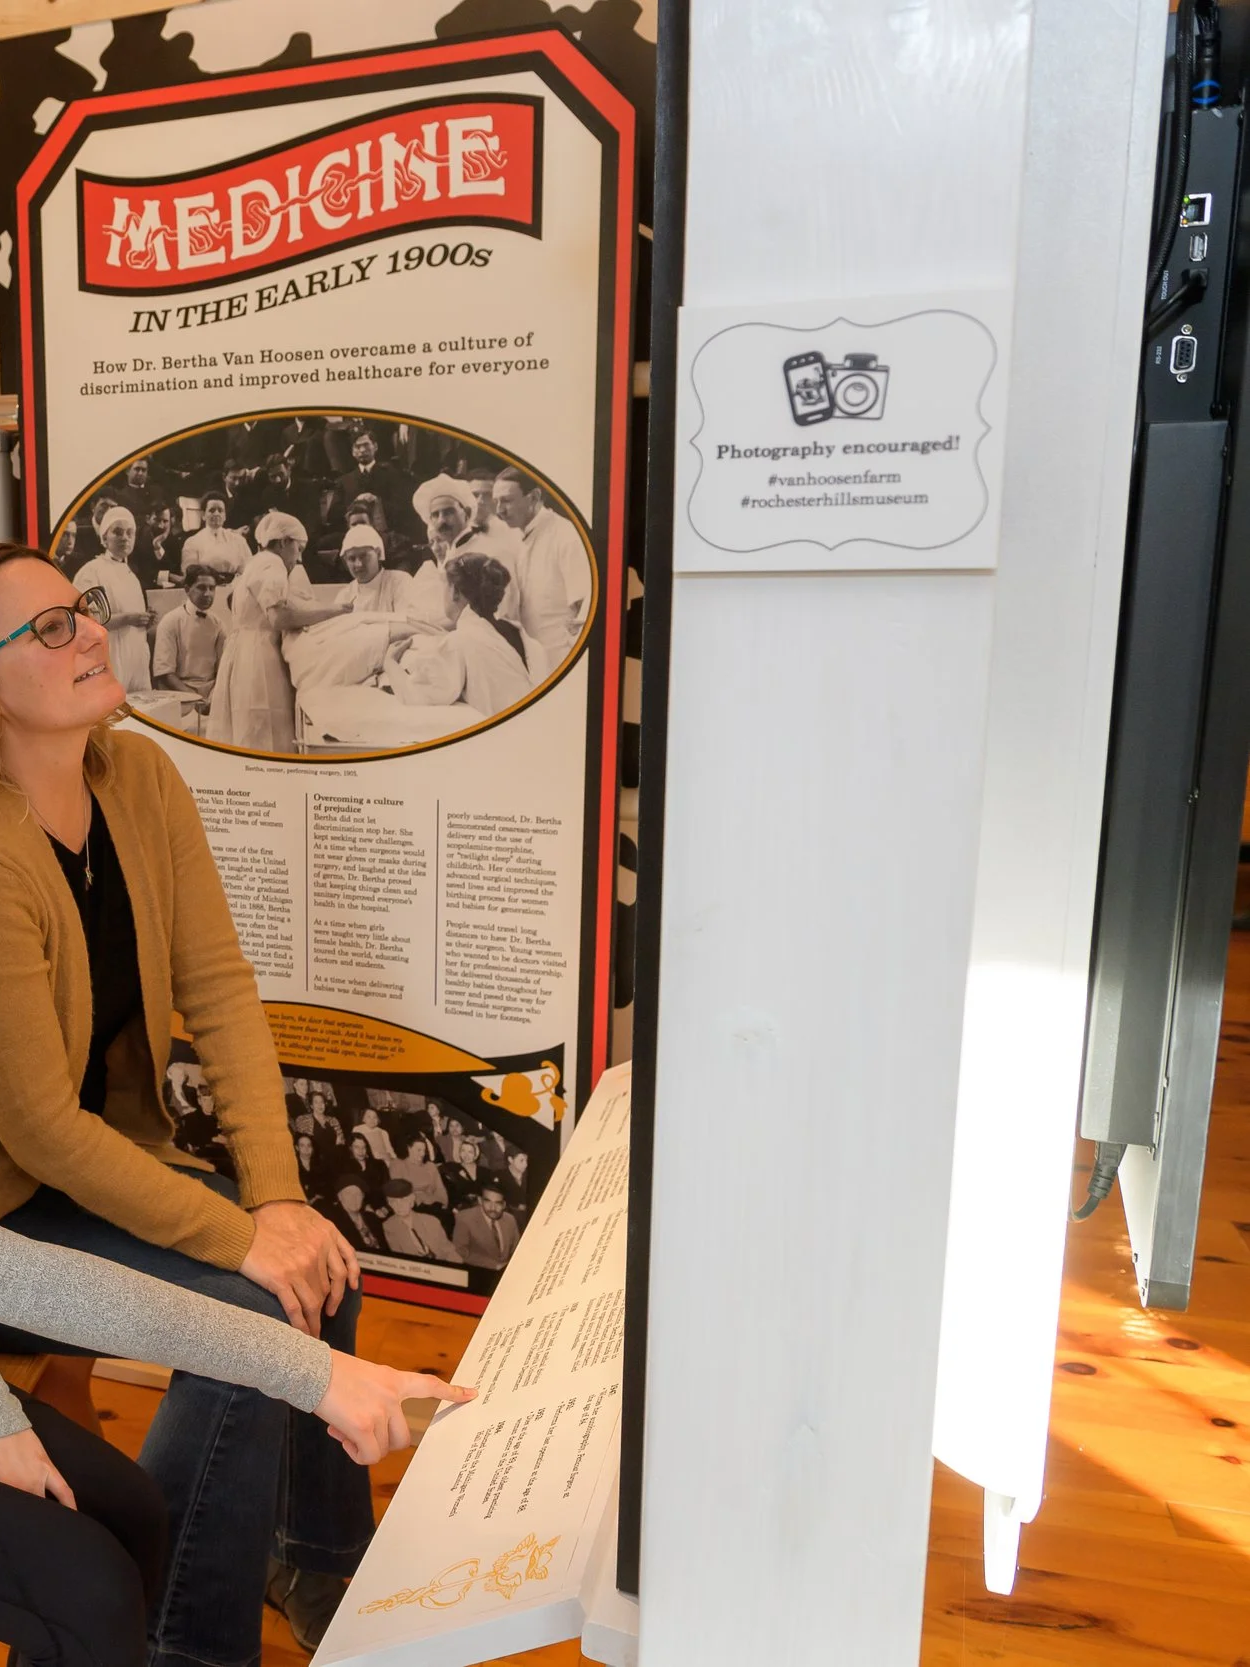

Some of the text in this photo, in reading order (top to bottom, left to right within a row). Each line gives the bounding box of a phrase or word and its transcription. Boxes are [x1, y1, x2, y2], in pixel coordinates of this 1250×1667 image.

[104, 115, 507, 271] MEDICINE
[128, 243, 493, 334] IN THE EARLY 1900s
[93, 332, 534, 374] How Dr. Bertha Van Hoosen overcame a culture of
[80, 358, 550, 396] discrimination and improved healthcare for everyone
[716, 435, 960, 460] Photography encouraged!
[768, 470, 901, 487] #vanhoosenfarm
[741, 492, 929, 509] #rochesterhillsmuseum
[226, 788, 250, 797] doctor
[211, 797, 276, 808] Van Hoosen studied
[313, 793, 363, 805] Overcoming
[373, 797, 403, 805] culture
[220, 807, 233, 815] with
[247, 809, 261, 817] goal
[313, 803, 361, 813] of prejudice
[234, 817, 249, 825] lives
[251, 818, 258, 826] of
[314, 813, 337, 821] Bertha
[339, 814, 351, 822] did
[367, 816, 376, 824] let
[447, 812, 470, 822] poorly
[535, 816, 561, 825] Bertha
[313, 823, 363, 833] discrimination
[399, 828, 413, 836] She
[313, 832, 328, 843] kept
[330, 834, 356, 843] seeking
[446, 831, 476, 841] delivery
[478, 833, 492, 841] and
[494, 834, 507, 842] the
[524, 836, 532, 844] of
[260, 847, 273, 855] first
[345, 854, 366, 864] gloves
[378, 857, 400, 865] masks
[402, 858, 426, 868] during
[515, 856, 542, 866] during
[358, 864, 386, 874] laughed
[411, 868, 426, 876] idea
[488, 864, 503, 872] Her
[505, 866, 556, 876] contributions
[362, 874, 385, 883] Bertha
[313, 880, 327, 888] that
[329, 881, 356, 892] keeping
[358, 884, 380, 893] things
[382, 886, 401, 894] clean
[313, 899, 335, 908] health
[347, 902, 358, 910] the
[313, 936, 336, 945] female
[379, 943, 403, 952] Bertha
[313, 955, 338, 964] doctors
